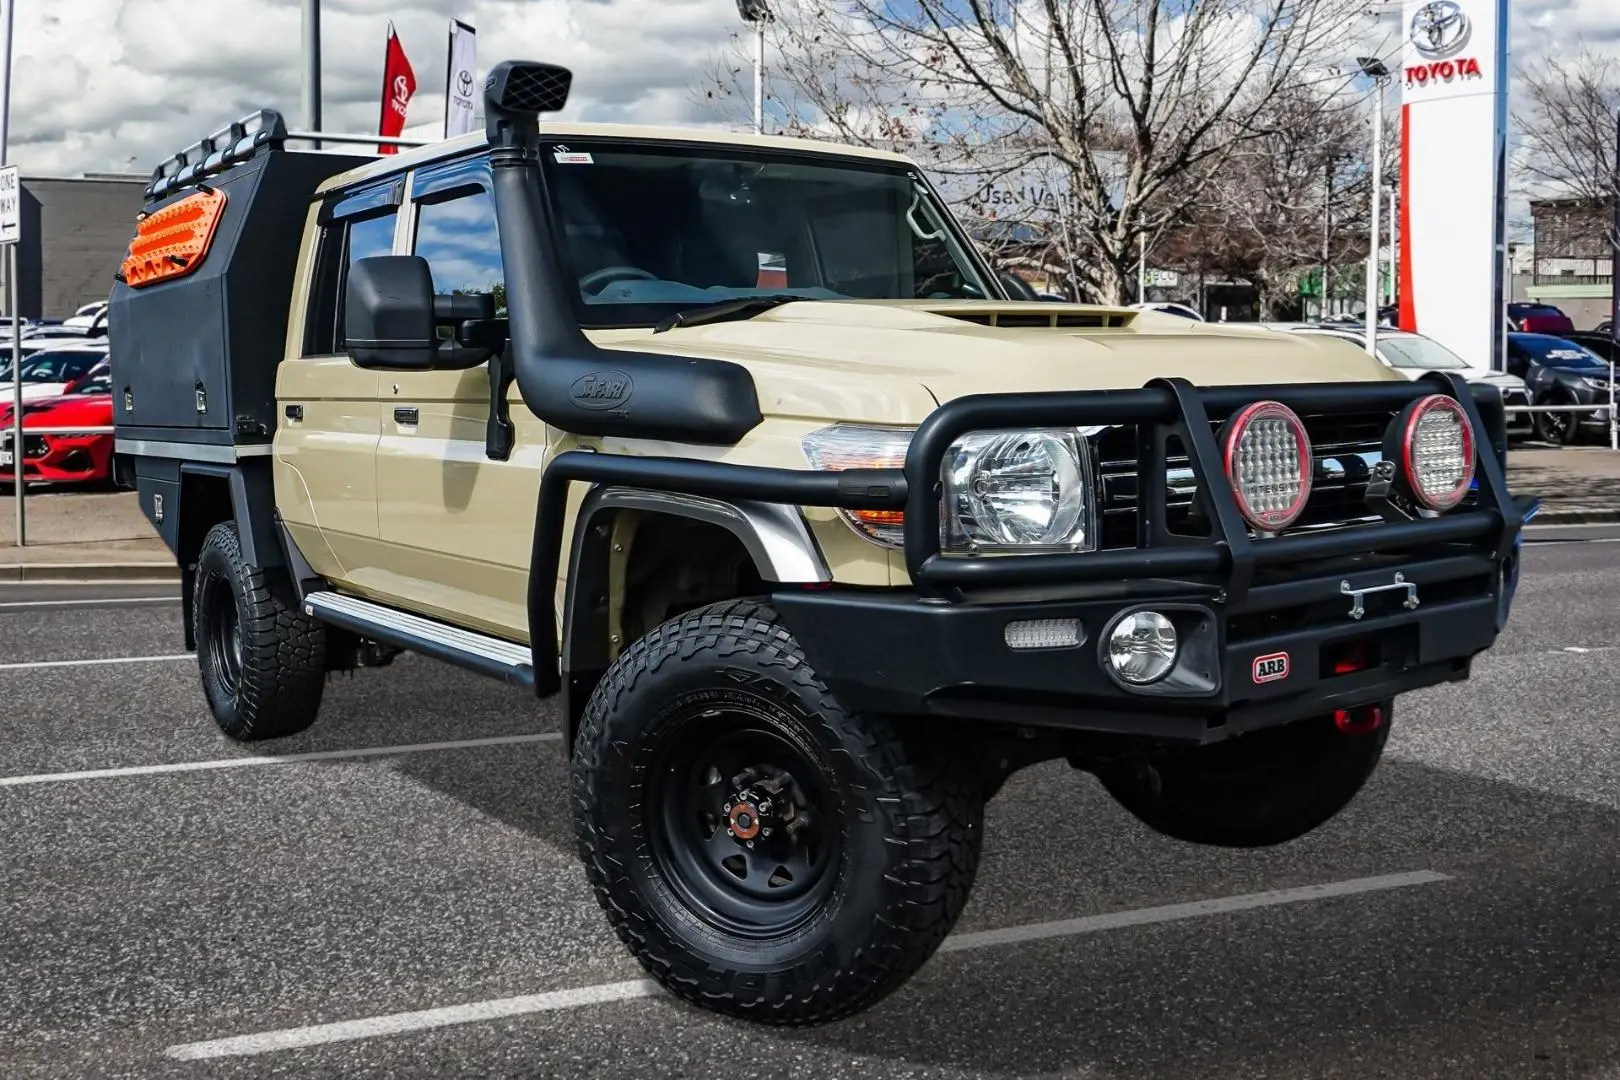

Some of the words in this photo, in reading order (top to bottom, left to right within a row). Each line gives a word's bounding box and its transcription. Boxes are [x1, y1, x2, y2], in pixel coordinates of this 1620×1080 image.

[1404, 58, 1480, 82] TOYOTA
[0, 174, 15, 191] ONE
[574, 377, 627, 399] SAFARI
[1247, 482, 1300, 494] INTENSITY
[1258, 659, 1285, 677] ARB
